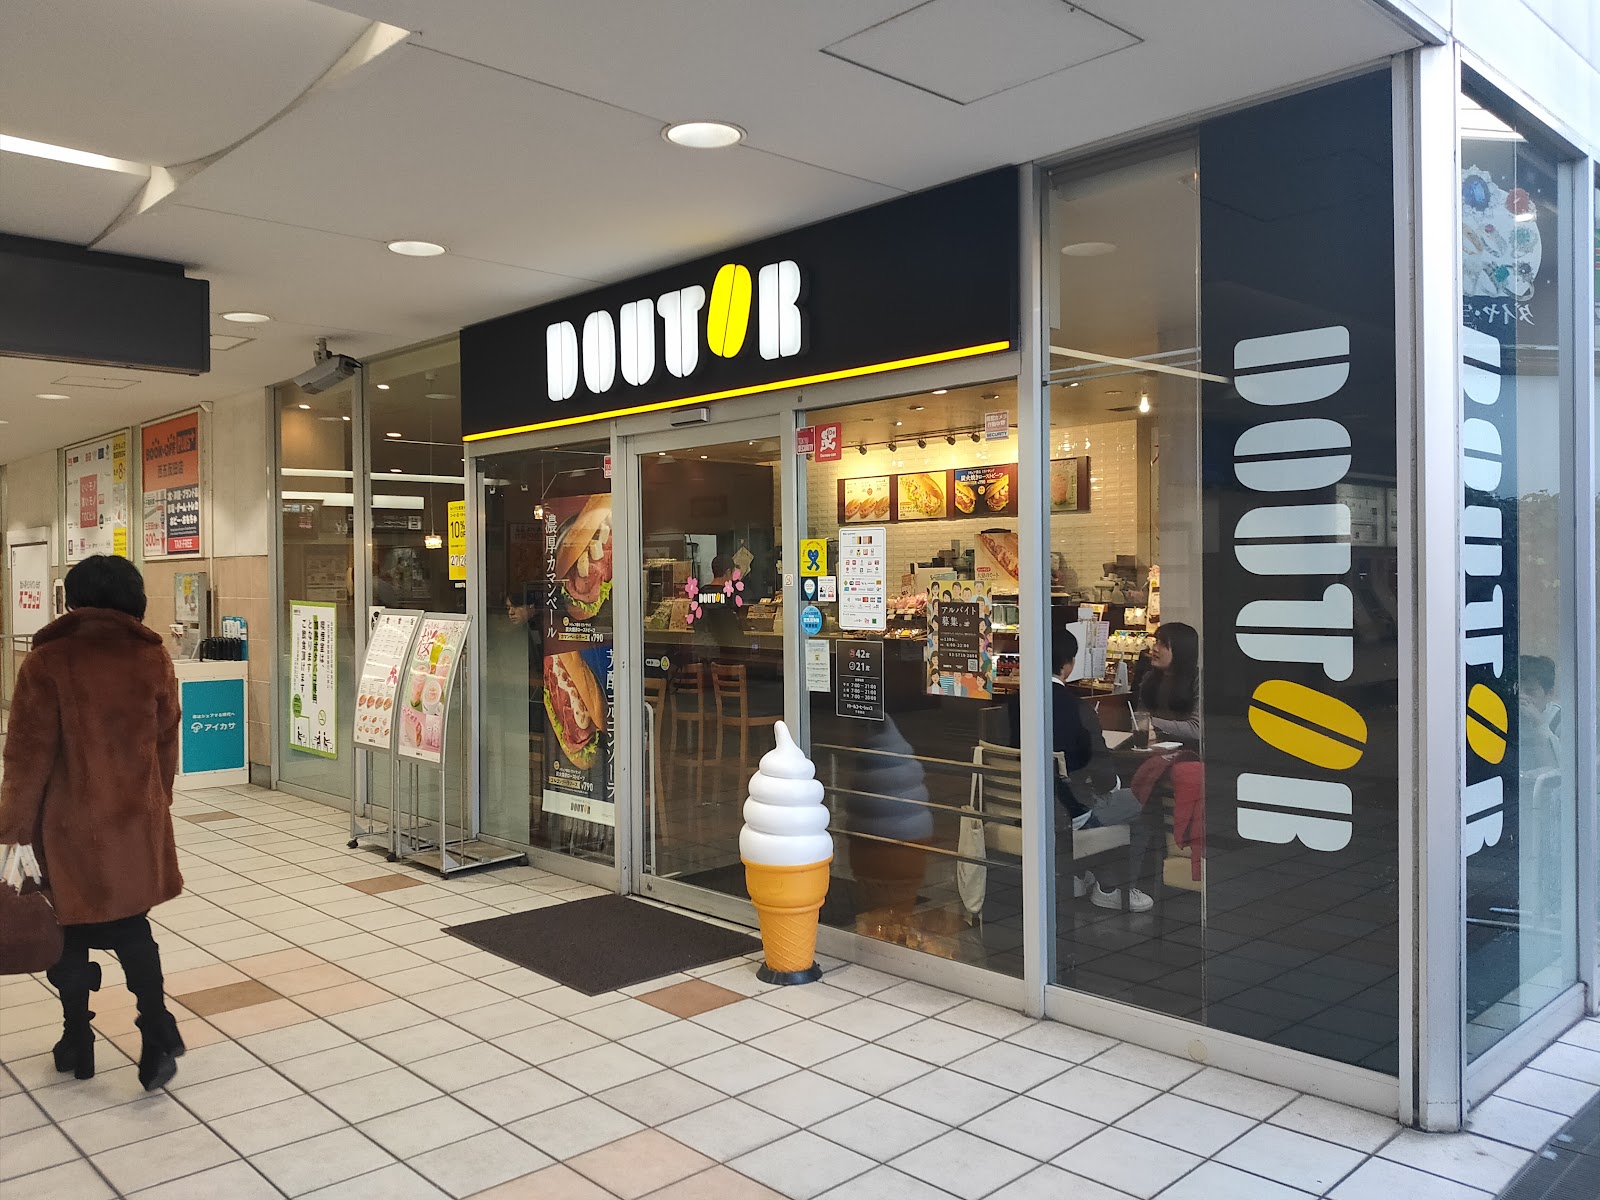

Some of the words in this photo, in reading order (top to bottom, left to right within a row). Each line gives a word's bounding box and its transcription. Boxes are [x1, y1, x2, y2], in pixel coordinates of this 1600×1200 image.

[546, 260, 802, 402] DOUTOR
[544, 513, 558, 639] 濃厚カマンベール
[1233, 325, 1368, 852] DOUTOR
[1463, 327, 1509, 858] DOUTOR
[698, 592, 726, 604] DOUTOR
[941, 606, 977, 616] アルバイト
[591, 633, 604, 643] ¥790
[204, 722, 236, 731] アイカサ
[581, 782, 594, 792] ¥790
[570, 801, 591, 815] DOUTOR
